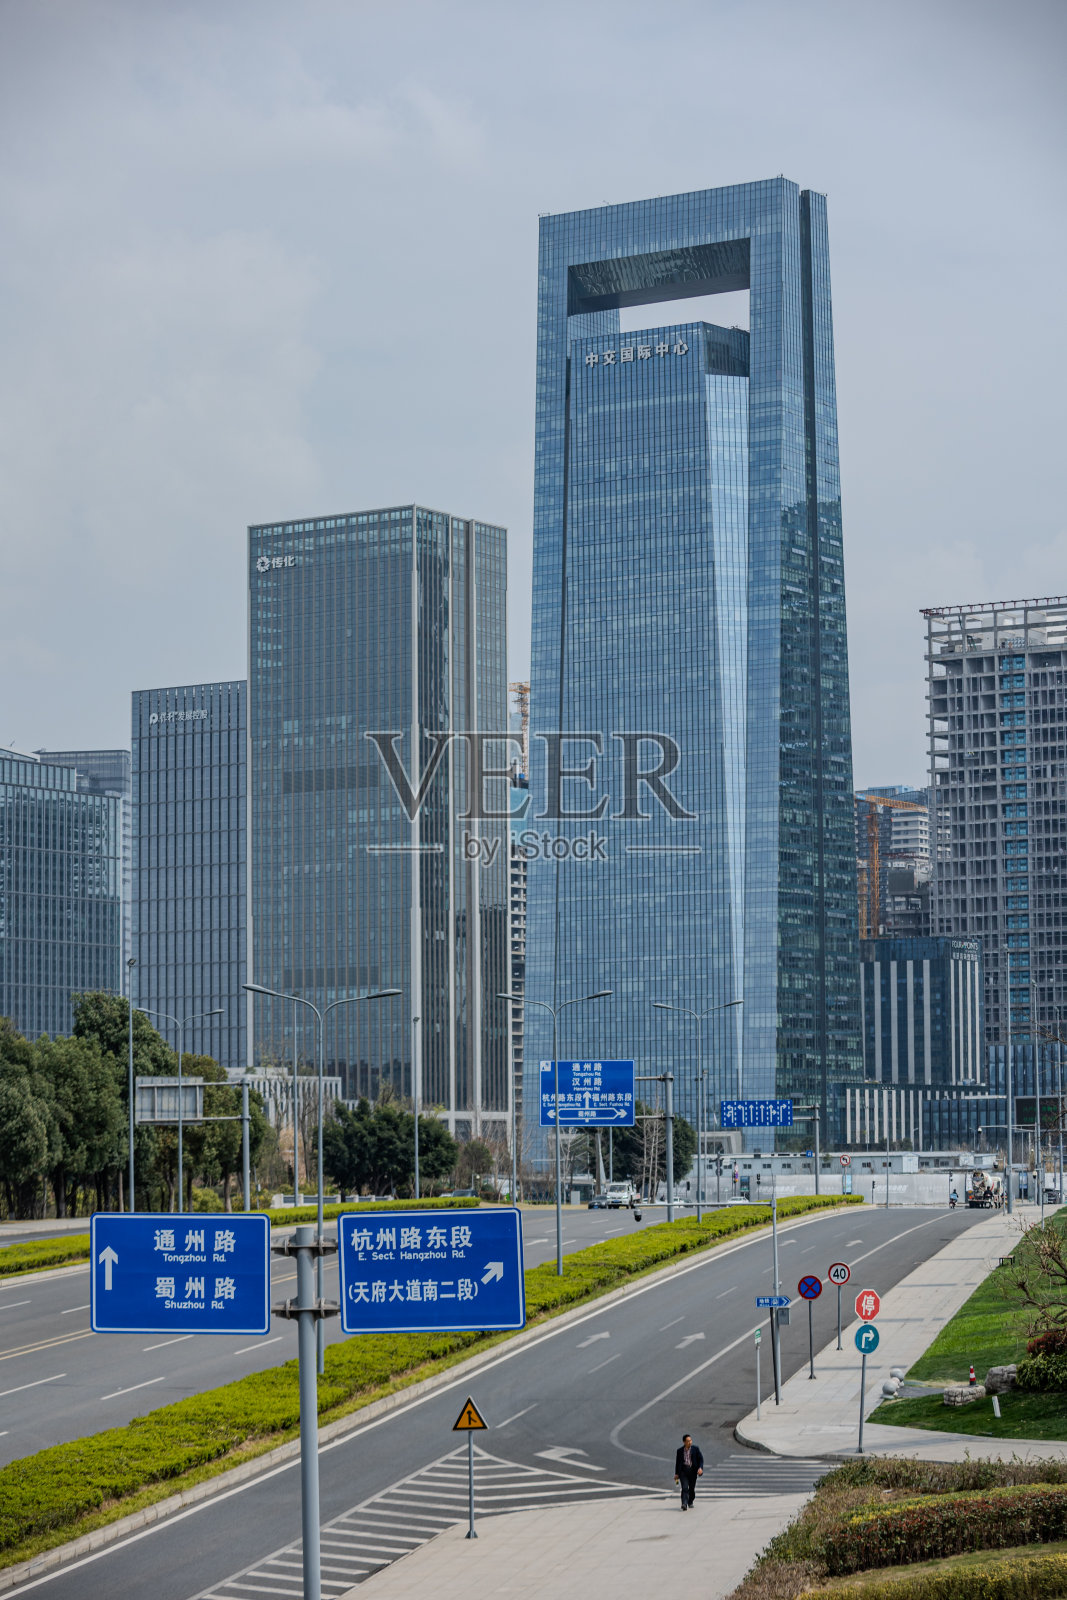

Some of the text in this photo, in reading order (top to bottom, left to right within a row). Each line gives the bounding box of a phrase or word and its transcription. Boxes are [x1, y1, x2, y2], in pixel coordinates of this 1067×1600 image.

[585, 339, 689, 368] 中交国际中心
[572, 1063, 602, 1071] 通州路
[572, 1078, 602, 1086] 汉州路
[592, 1093, 632, 1102] 福州路东段
[153, 1229, 237, 1252] 通州路
[351, 1225, 473, 1251] 杭州路东段
[162, 1253, 227, 1264] Tongzhou Rd.
[358, 1249, 466, 1262] E. Sect. Hangzhou Rd.
[832, 1268, 847, 1279] 40
[154, 1277, 237, 1299] 蜀州路
[348, 1278, 479, 1304] (天府大道南二段)
[164, 1300, 225, 1309] Shuzhou Rd.
[862, 1295, 875, 1316] 停
